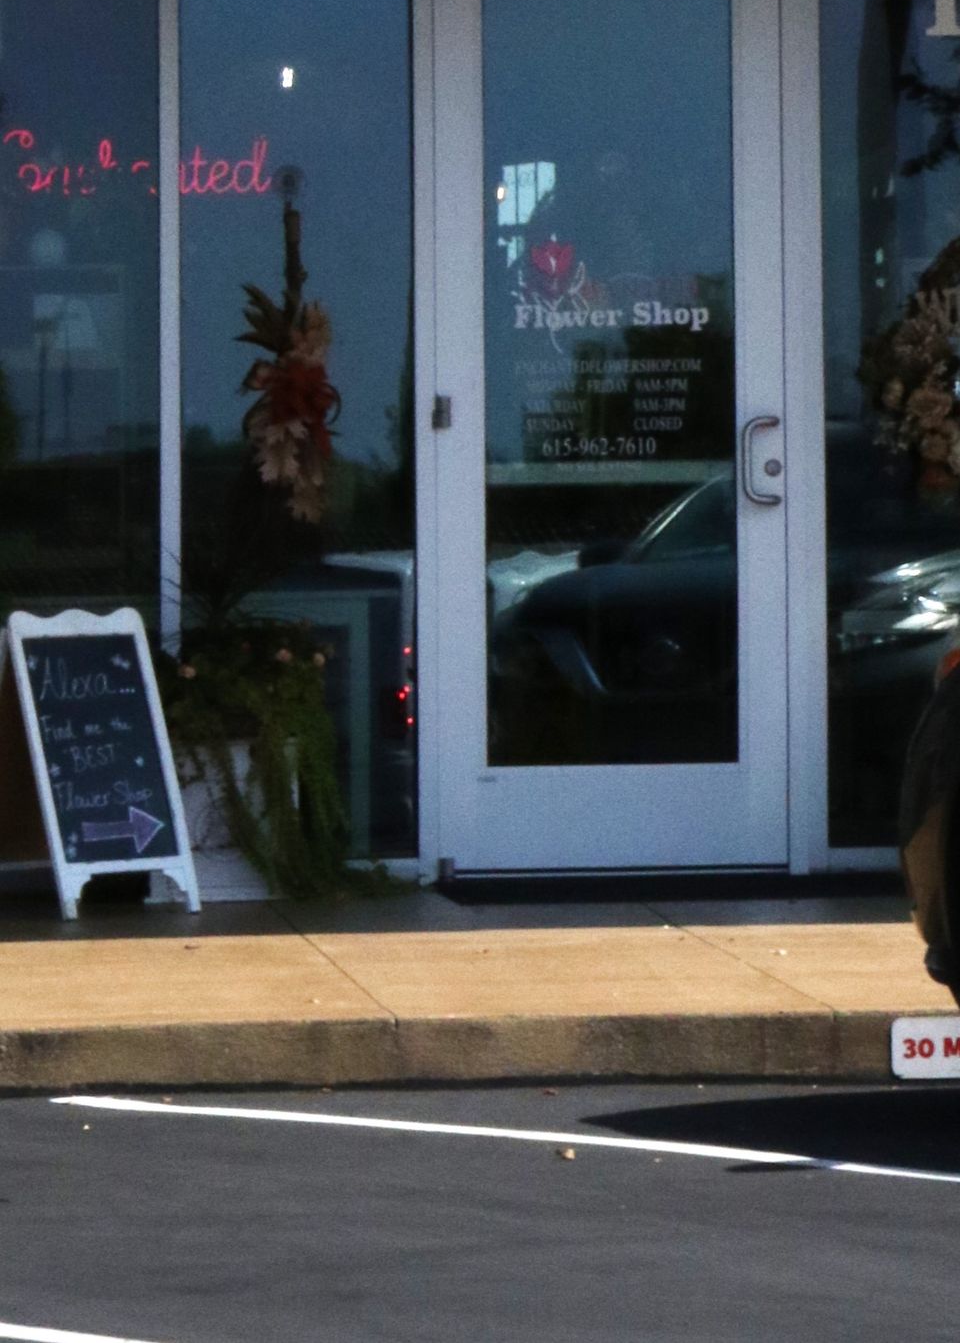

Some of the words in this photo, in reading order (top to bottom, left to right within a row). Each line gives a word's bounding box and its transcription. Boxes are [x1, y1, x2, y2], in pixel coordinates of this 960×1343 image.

[514, 302, 623, 330] Flower
[632, 300, 709, 332] Shop
[633, 417, 683, 432] CLOSED
[542, 436, 657, 457] 615-962-7610
[39, 715, 77, 743] Find
[52, 780, 111, 814] Flower
[903, 1037, 934, 1059] 30
